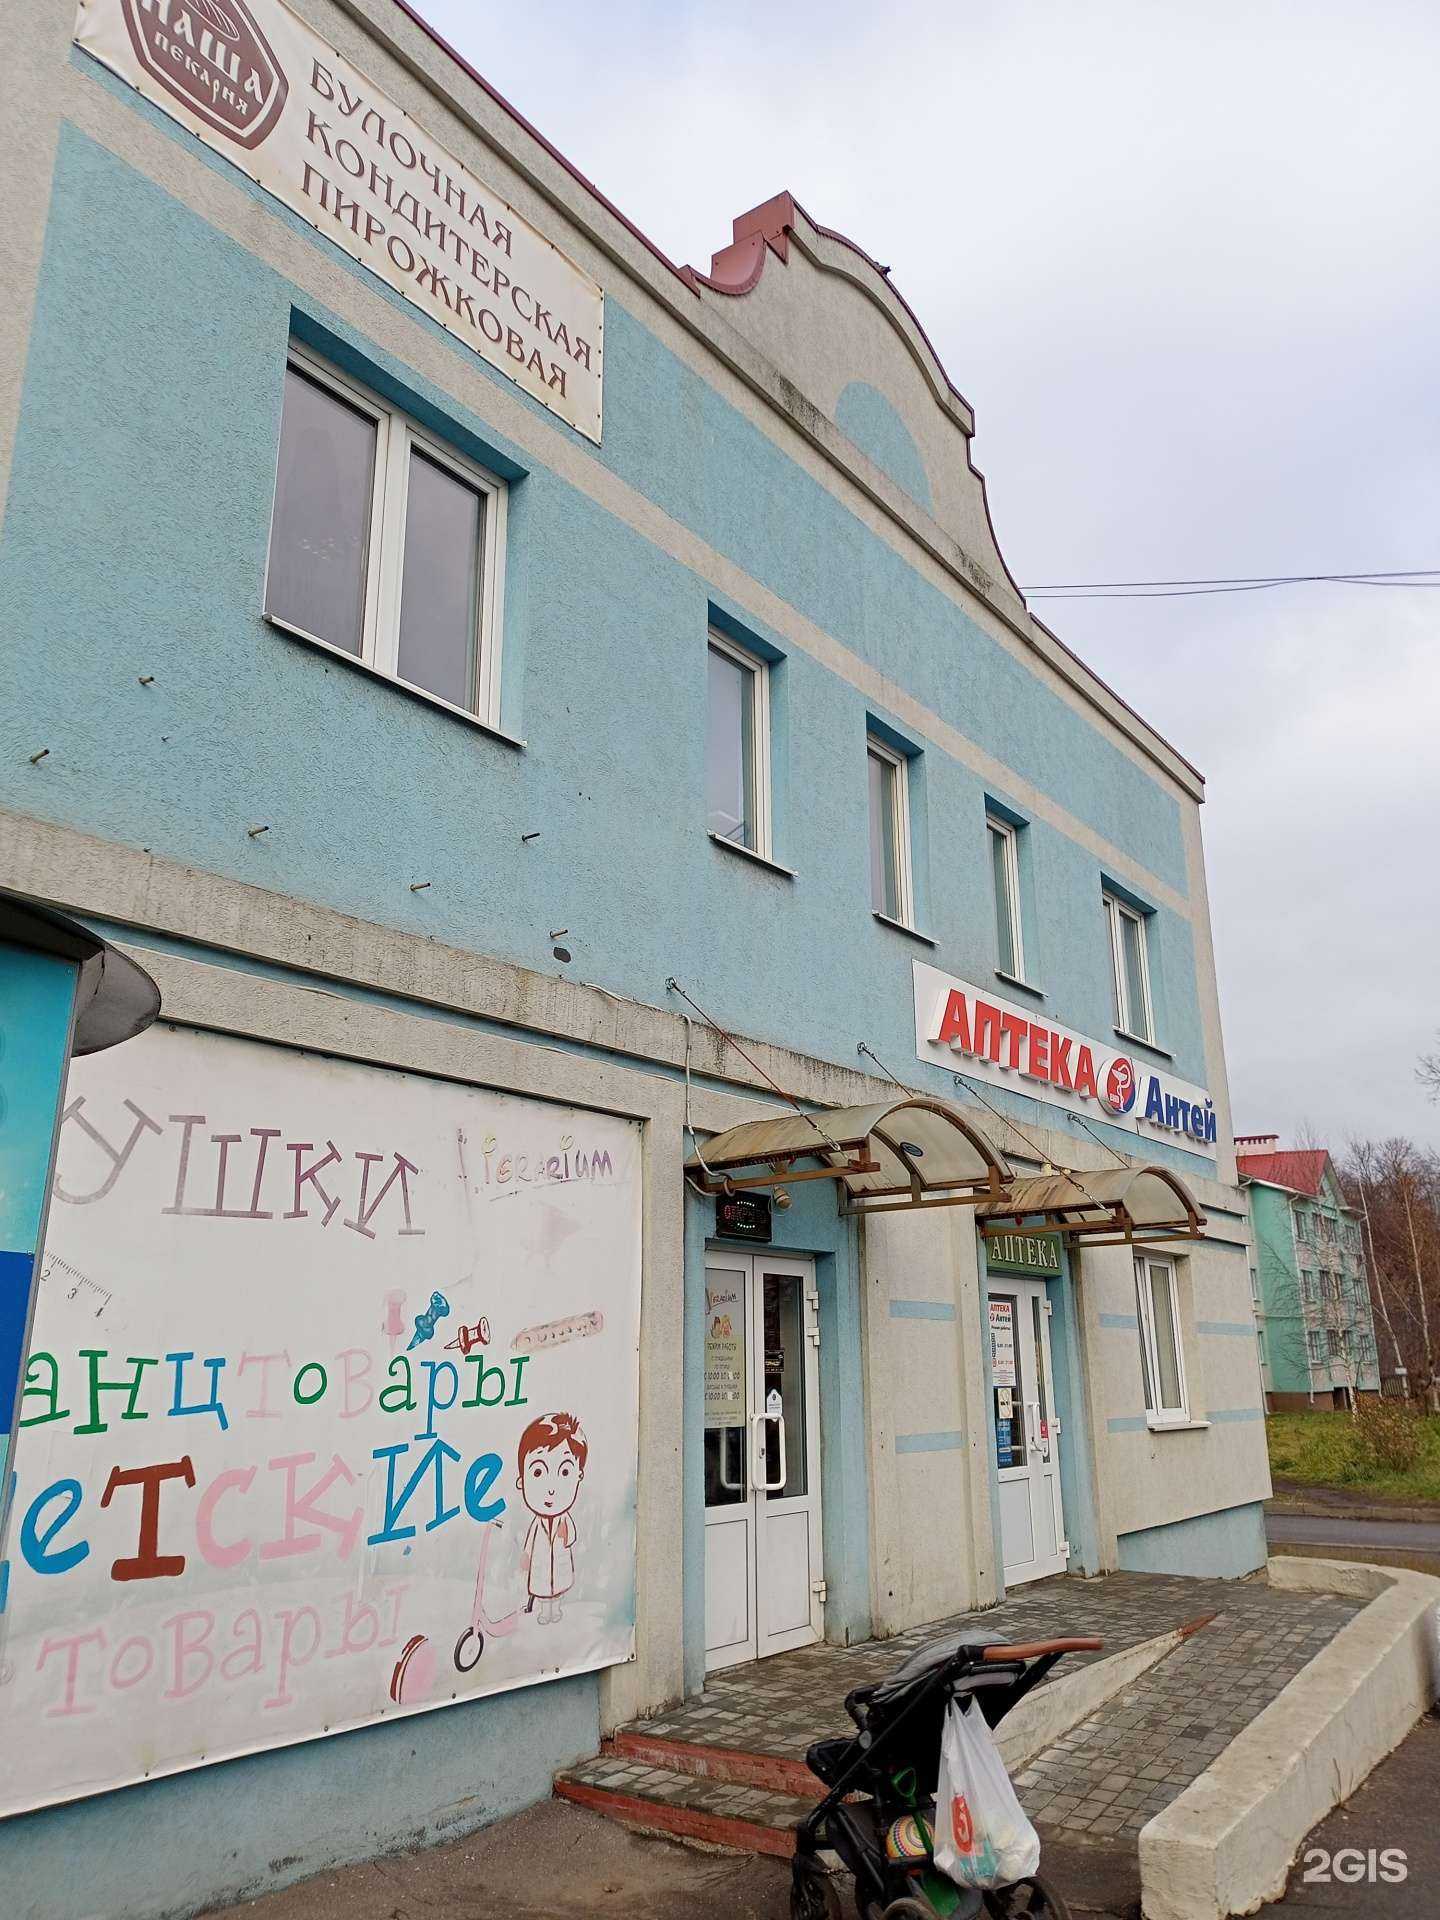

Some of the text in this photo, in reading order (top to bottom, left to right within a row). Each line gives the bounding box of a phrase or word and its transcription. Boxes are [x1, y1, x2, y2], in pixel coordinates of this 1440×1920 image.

[305, 108, 592, 371] КОНДИТЕРСКАЯ
[309, 57, 513, 258] БУЛОЧНАЯ
[300, 161, 567, 398] ПИРОЖКОВАЯ
[936, 988, 1217, 1144] АПТЕКА Антей
[991, 1233, 1060, 1269] АПТЕКА
